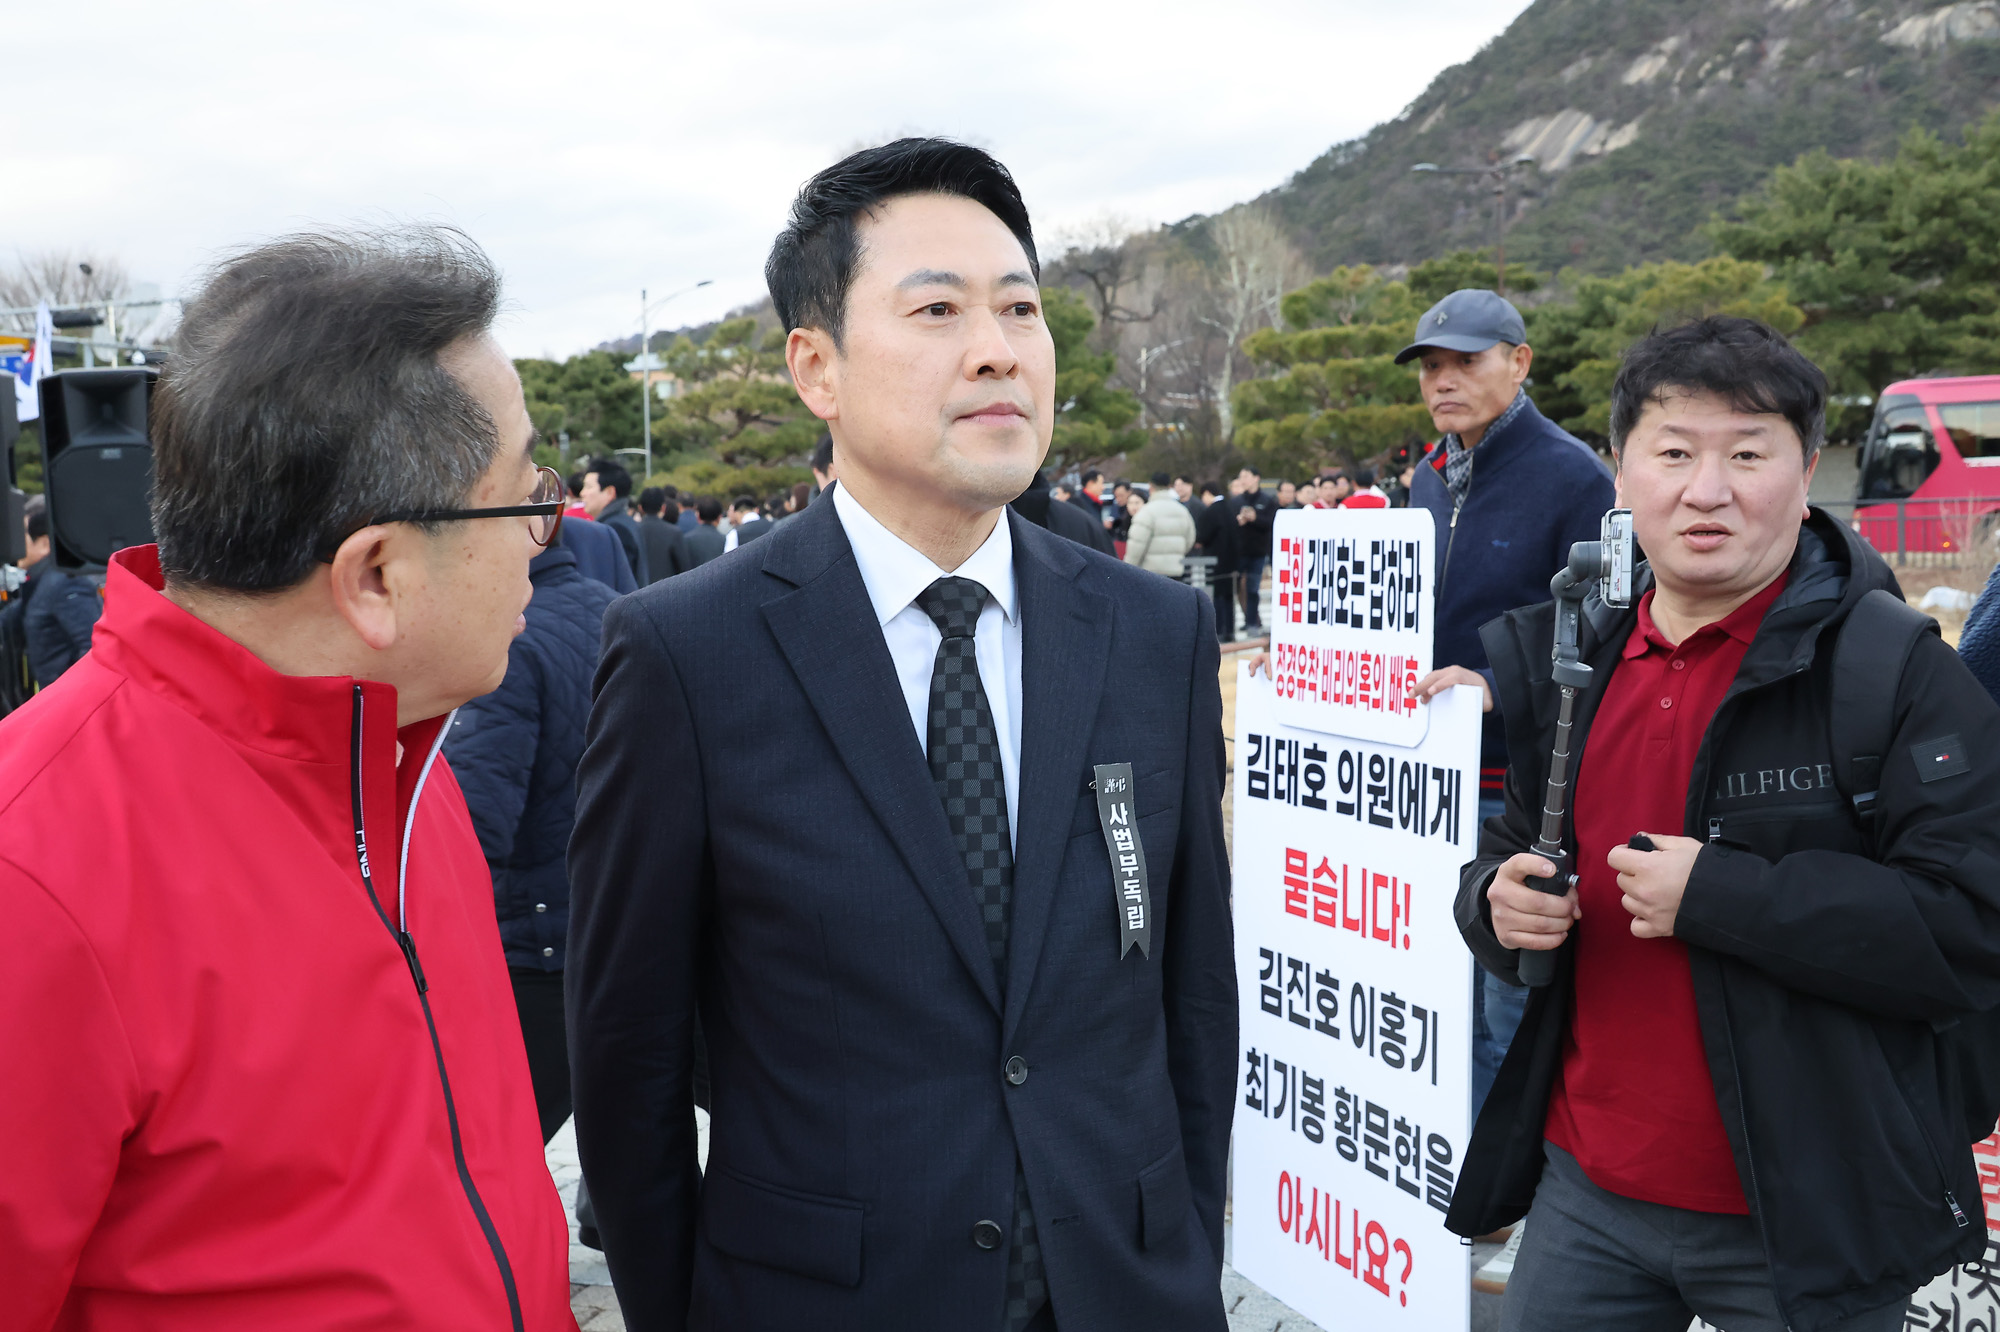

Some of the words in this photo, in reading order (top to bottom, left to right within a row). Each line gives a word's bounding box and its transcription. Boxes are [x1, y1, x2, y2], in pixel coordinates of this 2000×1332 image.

[1279, 536, 1304, 623] 국힘
[1307, 537, 1366, 630] 김태호는
[1370, 539, 1422, 634] 답하라
[1276, 642, 1320, 704] 정경유착
[1321, 647, 1387, 713] 비리의혹의
[1388, 654, 1419, 719] 배후
[1247, 733, 1328, 812] 김태호
[1336, 749, 1462, 846] 의원에게
[1109, 802, 1145, 931] 사법부독립
[1283, 847, 1411, 951] 묻습니다!
[1259, 946, 1341, 1041] 김진호
[1350, 981, 1439, 1087] 이홍기
[1245, 1046, 1326, 1145] 최기봉
[1333, 1085, 1454, 1215] 황문현을
[1277, 1170, 1413, 1308] 아시나요?
